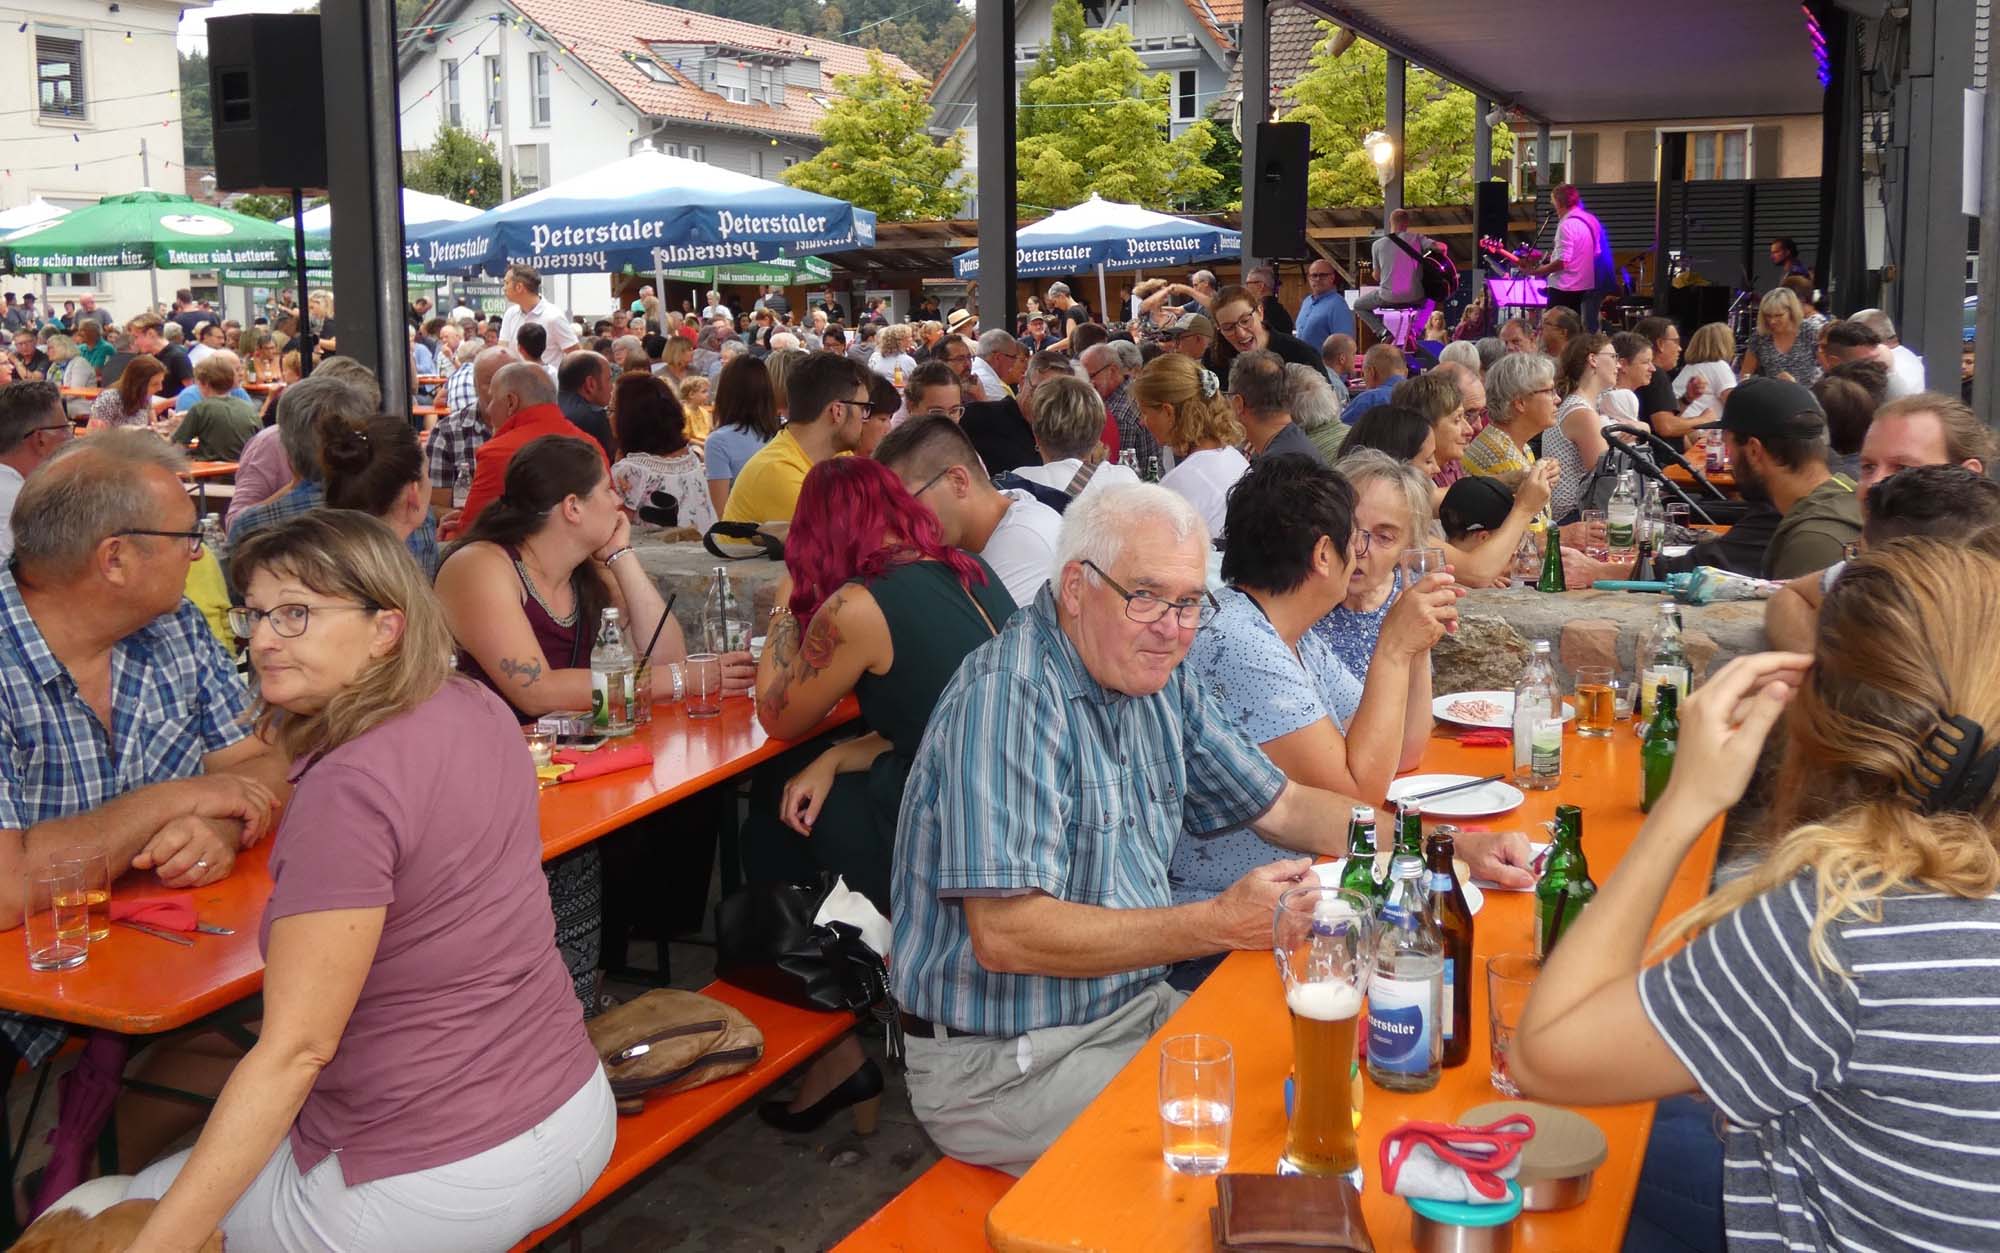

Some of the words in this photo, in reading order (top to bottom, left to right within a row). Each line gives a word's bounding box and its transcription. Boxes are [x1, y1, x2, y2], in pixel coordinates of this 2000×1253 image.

[717, 210, 827, 239] Peterstaler
[531, 219, 664, 254] Peterstaler
[1127, 236, 1200, 257] Peterstaler
[15, 253, 39, 268] Ganz
[42, 252, 74, 267] schön
[76, 254, 119, 267] netterer
[211, 249, 233, 264] sind
[429, 235, 489, 269] Peterstaler
[1016, 245, 1092, 267] Peterstaler
[960, 258, 979, 276] Peters
